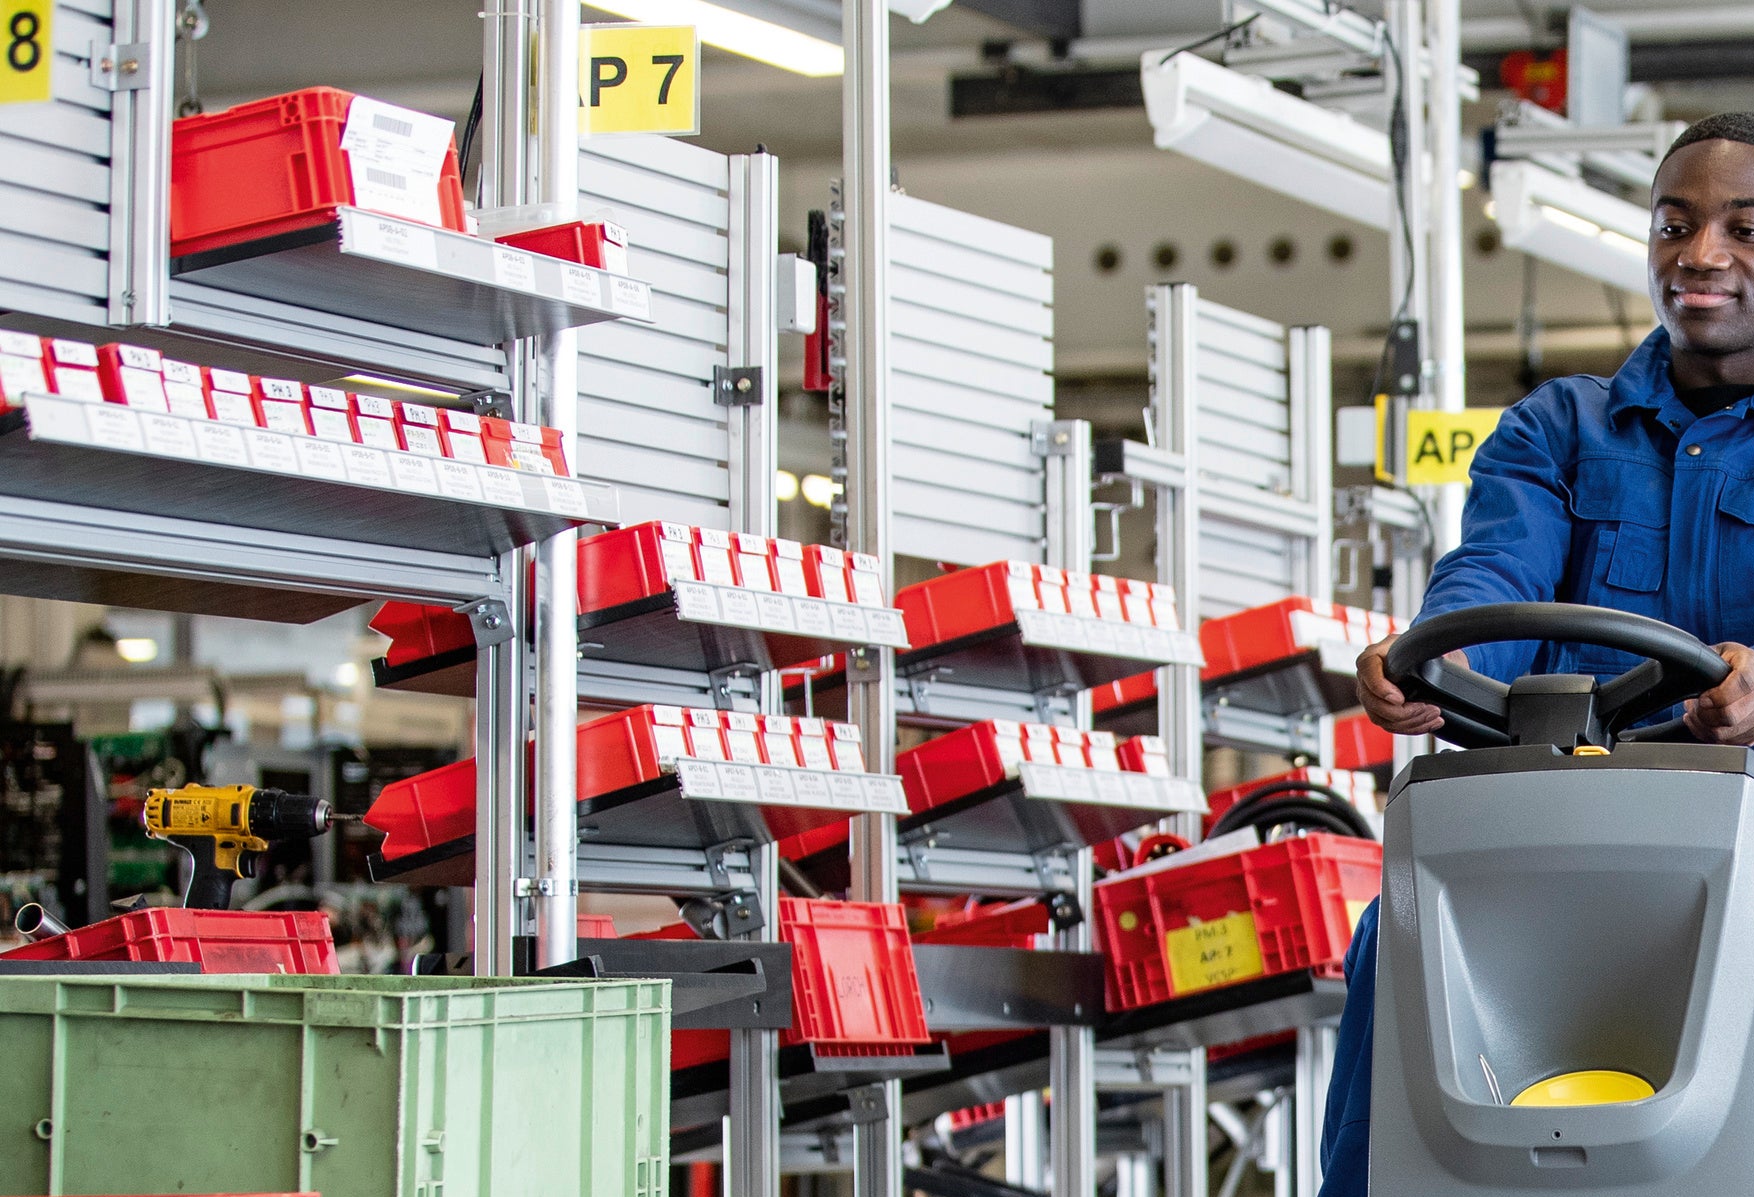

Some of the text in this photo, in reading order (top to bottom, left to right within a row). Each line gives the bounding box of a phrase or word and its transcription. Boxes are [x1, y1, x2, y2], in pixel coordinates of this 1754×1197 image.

[8, 11, 40, 72] 8
[579, 55, 684, 107] P 7
[1414, 430, 1474, 463] AP
